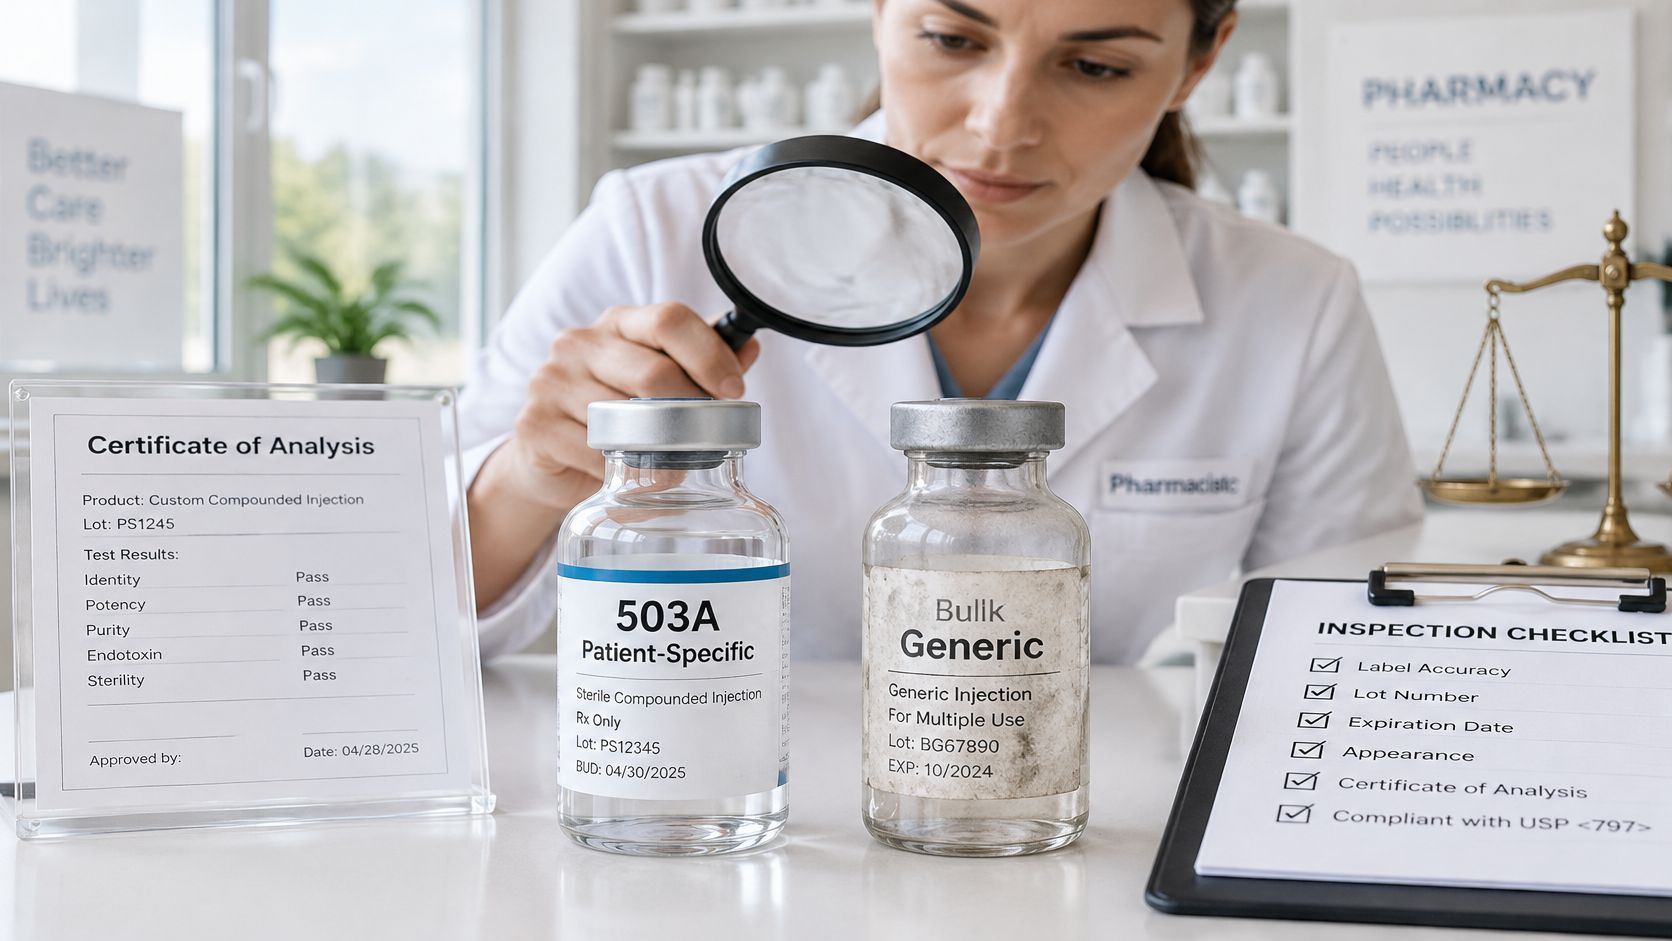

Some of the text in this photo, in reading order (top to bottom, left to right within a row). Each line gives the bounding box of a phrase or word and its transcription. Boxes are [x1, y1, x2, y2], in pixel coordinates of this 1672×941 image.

[1363, 68, 1596, 108] PHARMACY
[28, 138, 129, 181] Better
[1370, 139, 1471, 163] PEOPLE
[1369, 175, 1482, 196] HEALTH
[26, 185, 103, 224] Care
[27, 231, 154, 276] Brighter
[27, 278, 110, 314] Lives
[87, 435, 375, 460] Certificate of Analysis
[82, 493, 364, 508] Product: Custom Compounded Injection
[83, 517, 175, 531] Lot: PS1245
[83, 548, 179, 561] Test Results:
[84, 573, 141, 589] Identity
[296, 571, 330, 583] Pass
[86, 599, 146, 613] Potency
[297, 595, 331, 607] Pass
[299, 619, 333, 632] Pass
[616, 599, 721, 633] 503A
[86, 624, 130, 639] Purity
[1318, 622, 1672, 645] INSPECTION CHECKLIST
[87, 648, 162, 662] Endotoxin
[301, 645, 335, 657] Pass
[582, 639, 755, 668] Patient-Specific
[900, 628, 1044, 661] Generic
[303, 669, 337, 682] Pass
[1358, 661, 1512, 679] Label Accuracy
[87, 674, 145, 689] Sterility
[576, 686, 762, 708] Sterile Compounded Injection
[888, 682, 1032, 706] Generic Injection
[1354, 688, 1479, 703] Lot Number
[576, 710, 622, 731] Rx Only
[888, 707, 1025, 731] For Multiple Use
[1348, 716, 1514, 734] Expiration Date
[303, 742, 419, 758] Date: 04/28/2025
[576, 734, 661, 755] Lot: PS12345
[888, 733, 1000, 754] Lot: BG67890
[1342, 746, 1475, 762] Appearance
[89, 752, 182, 768] Approved by:
[576, 759, 686, 780] BUD: 04/30/2025
[888, 758, 994, 779] EXP: 10/2024
[1338, 777, 1588, 800] Certificate of Analysis
[1333, 810, 1651, 833] Compliant with USP <797>
